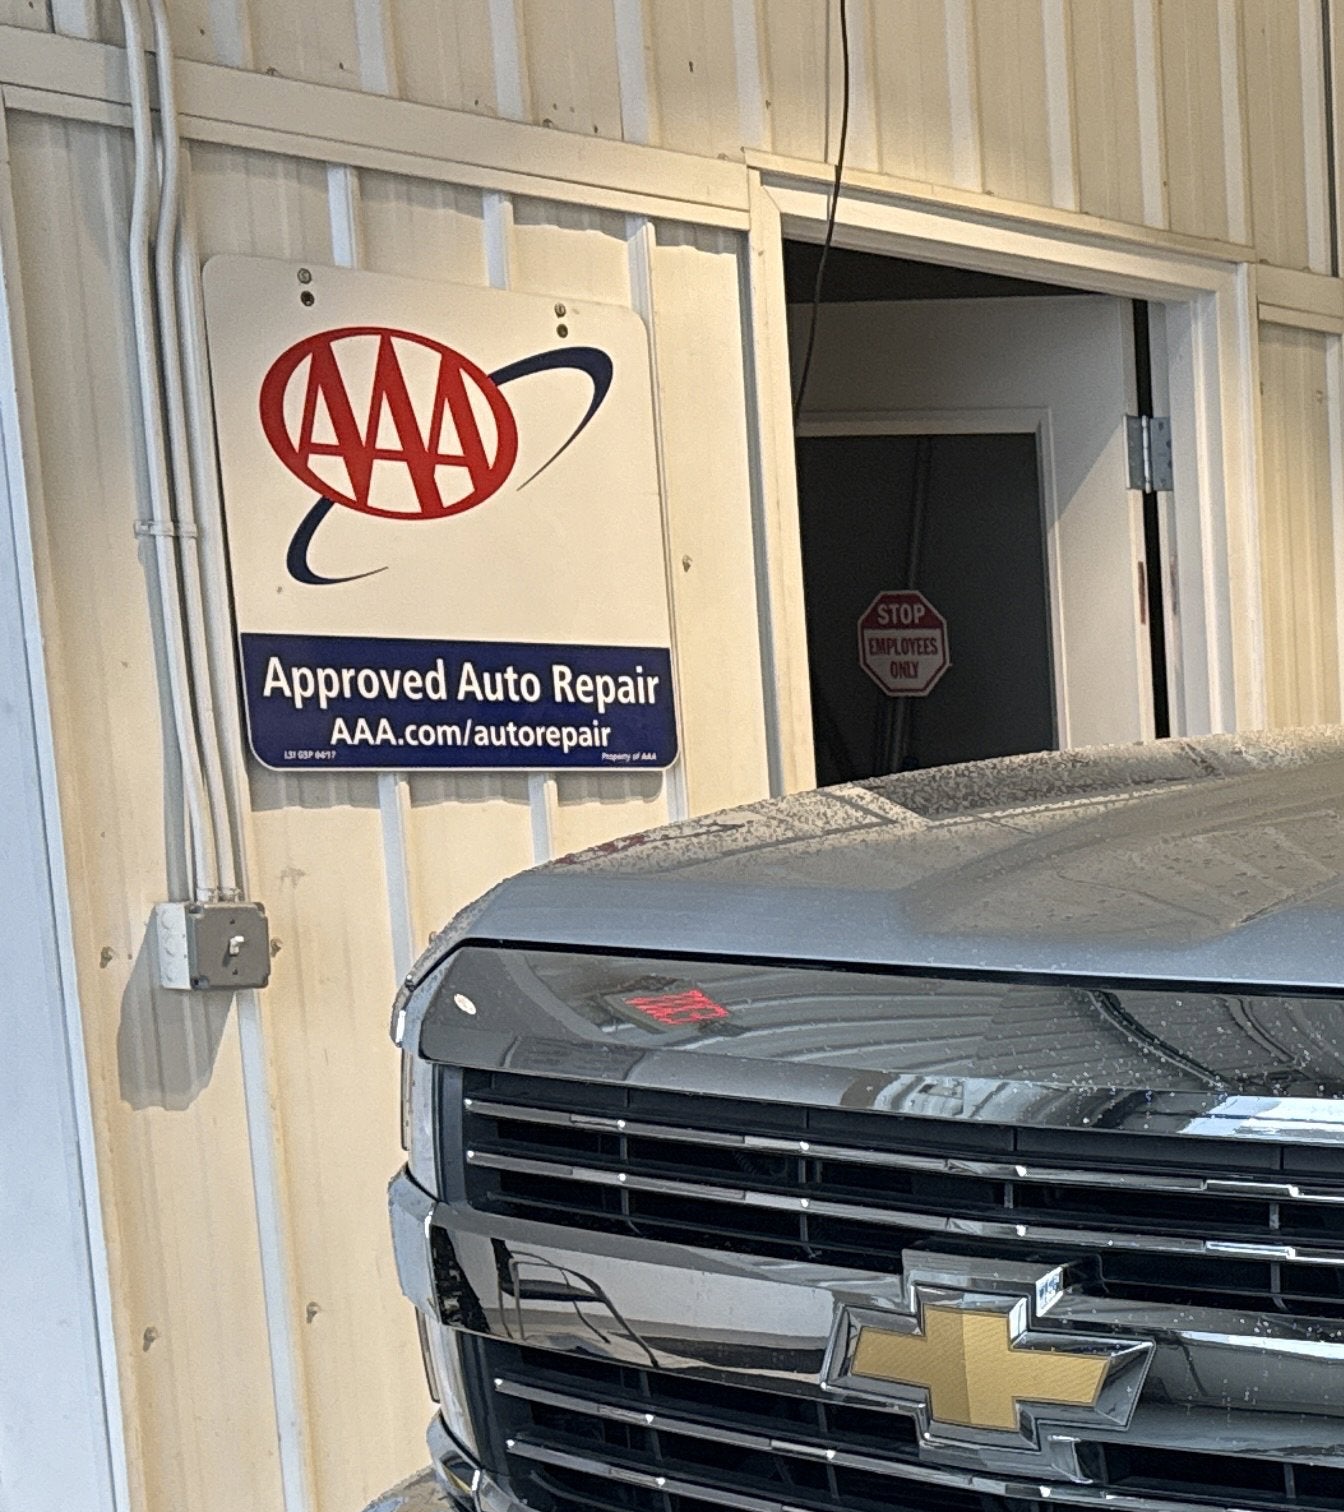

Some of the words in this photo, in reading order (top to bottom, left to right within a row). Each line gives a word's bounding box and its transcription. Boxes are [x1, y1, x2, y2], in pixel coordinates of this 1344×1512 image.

[261, 328, 517, 519] AAA
[877, 603, 925, 625] STOP
[868, 637, 938, 656] EMPLOYEES
[890, 660, 919, 679] ONLY
[263, 656, 447, 709] Approved
[457, 662, 541, 702] Auto
[553, 664, 660, 713] Repair
[330, 717, 612, 754] AAA.com/autorepair
